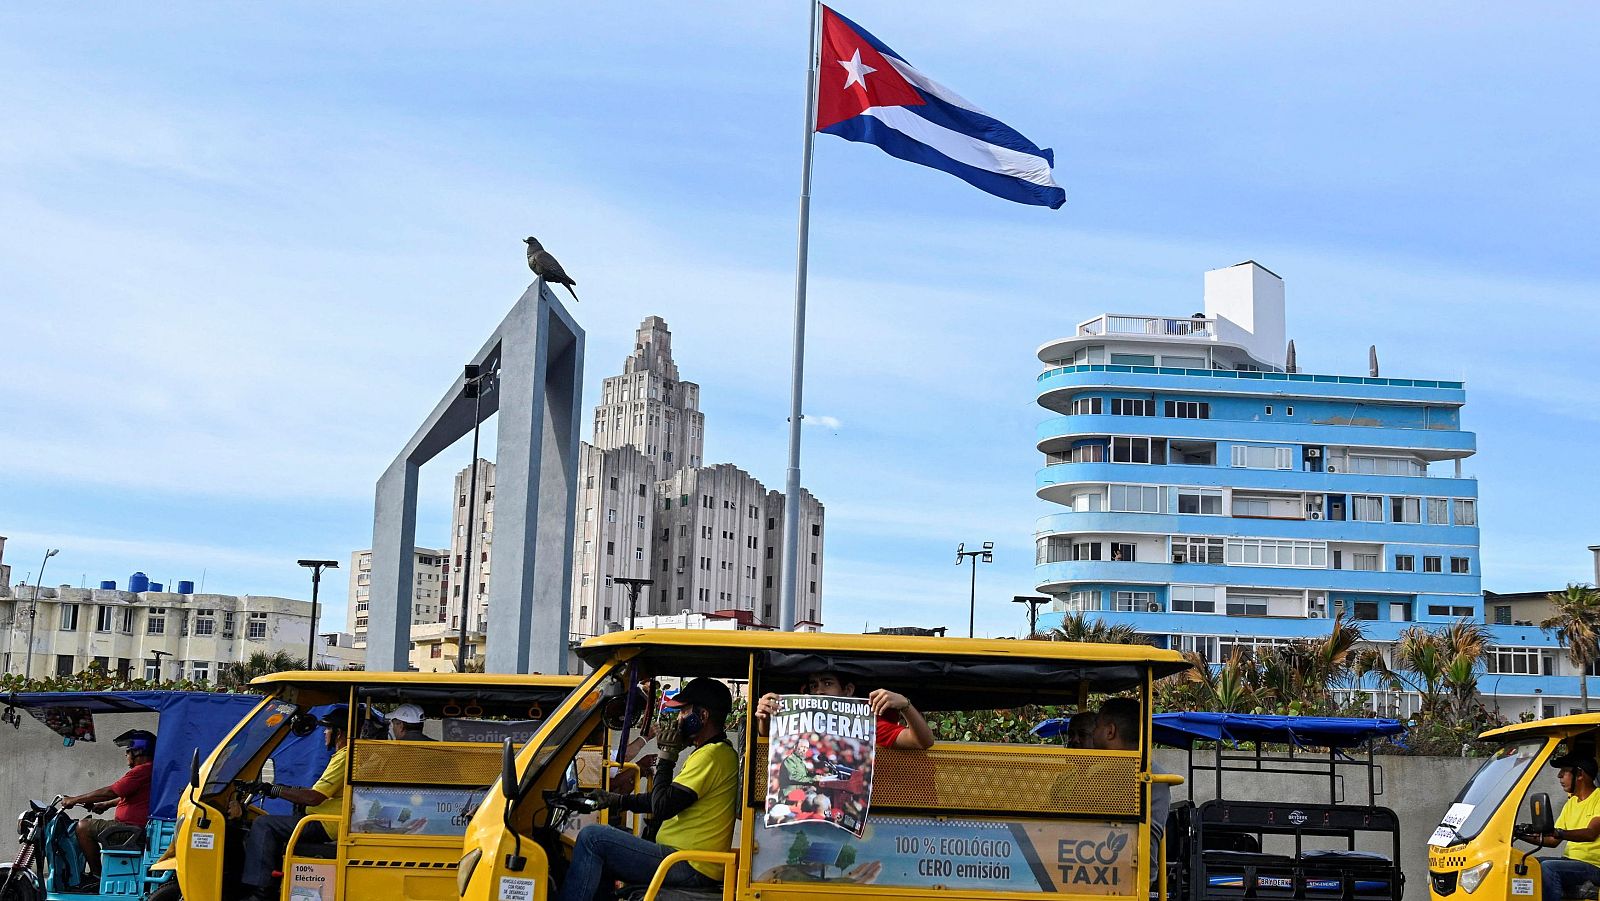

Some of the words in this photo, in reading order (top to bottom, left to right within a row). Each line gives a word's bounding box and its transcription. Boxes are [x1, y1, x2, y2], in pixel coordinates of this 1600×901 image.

[792, 698, 829, 711] PUEBLO
[831, 701, 870, 717] CUBANO
[776, 711, 870, 742] VENCERÁ!
[437, 802, 452, 813] 100
[451, 815, 467, 827] CER
[895, 836, 919, 854] 100
[923, 837, 936, 855] %
[940, 837, 1011, 858] ECOLÓGICO
[1057, 839, 1120, 865] ECO
[295, 865, 314, 873] 100%
[295, 874, 326, 882] Eléctrico
[918, 859, 952, 877] CERO
[956, 861, 1011, 880] emisión
[1057, 865, 1119, 886] TAXI
